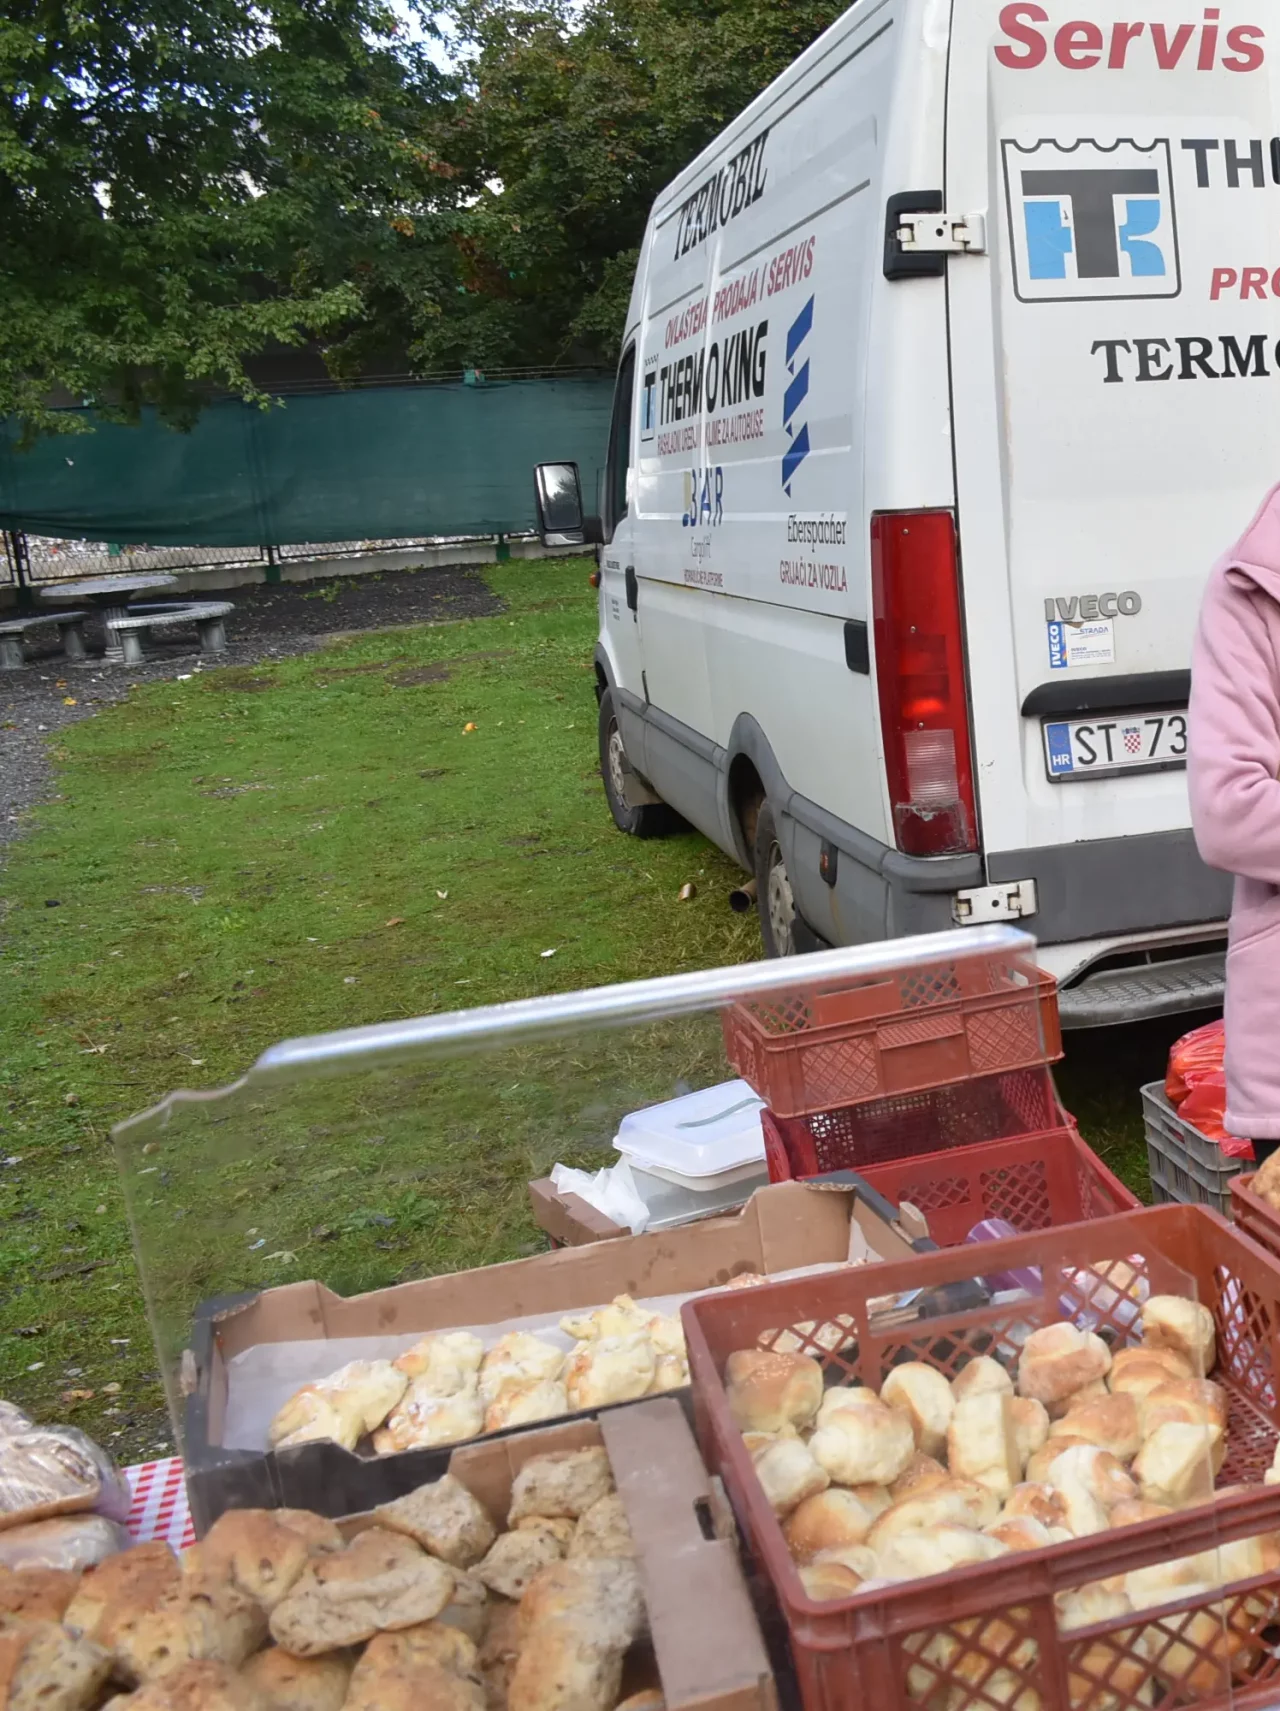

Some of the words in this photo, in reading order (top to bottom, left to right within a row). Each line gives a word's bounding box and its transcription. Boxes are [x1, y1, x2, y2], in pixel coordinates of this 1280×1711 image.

[993, 2, 1266, 72] Servis
[674, 128, 770, 261] TERMOBIL
[712, 265, 759, 325] PRODAJA
[767, 235, 816, 296] SERVIS
[721, 319, 769, 408] KING
[787, 512, 847, 552] Eberspächer
[808, 562, 819, 588] ZA
[818, 563, 848, 592] VOZILA
[1044, 591, 1142, 622] IVECO
[1049, 624, 1062, 666] IVECO
[1052, 754, 1070, 766] HR
[1074, 724, 1117, 764] ST
